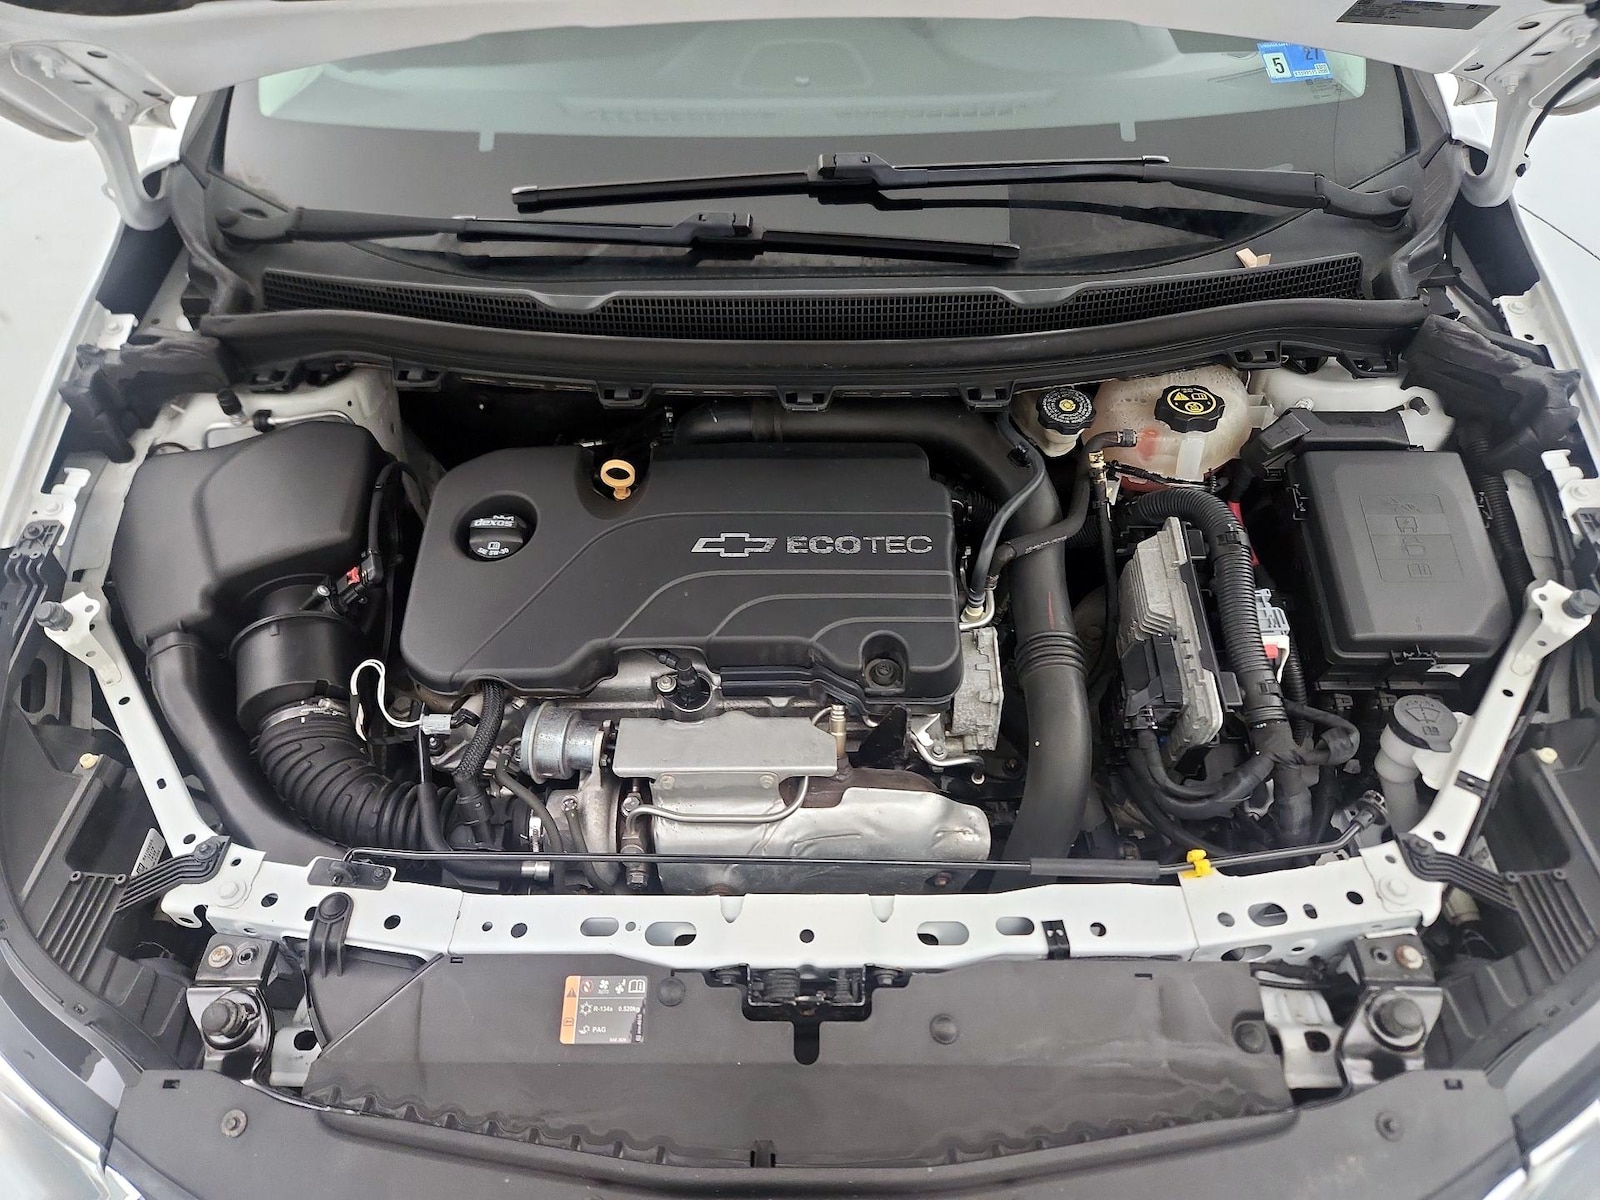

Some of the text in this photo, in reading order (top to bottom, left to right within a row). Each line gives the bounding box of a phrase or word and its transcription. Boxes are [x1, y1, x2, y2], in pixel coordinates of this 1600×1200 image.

[1304, 47, 1319, 61] 27
[1272, 57, 1285, 74] 5
[474, 518, 514, 527] dexos
[786, 535, 933, 554] ECOTEC
